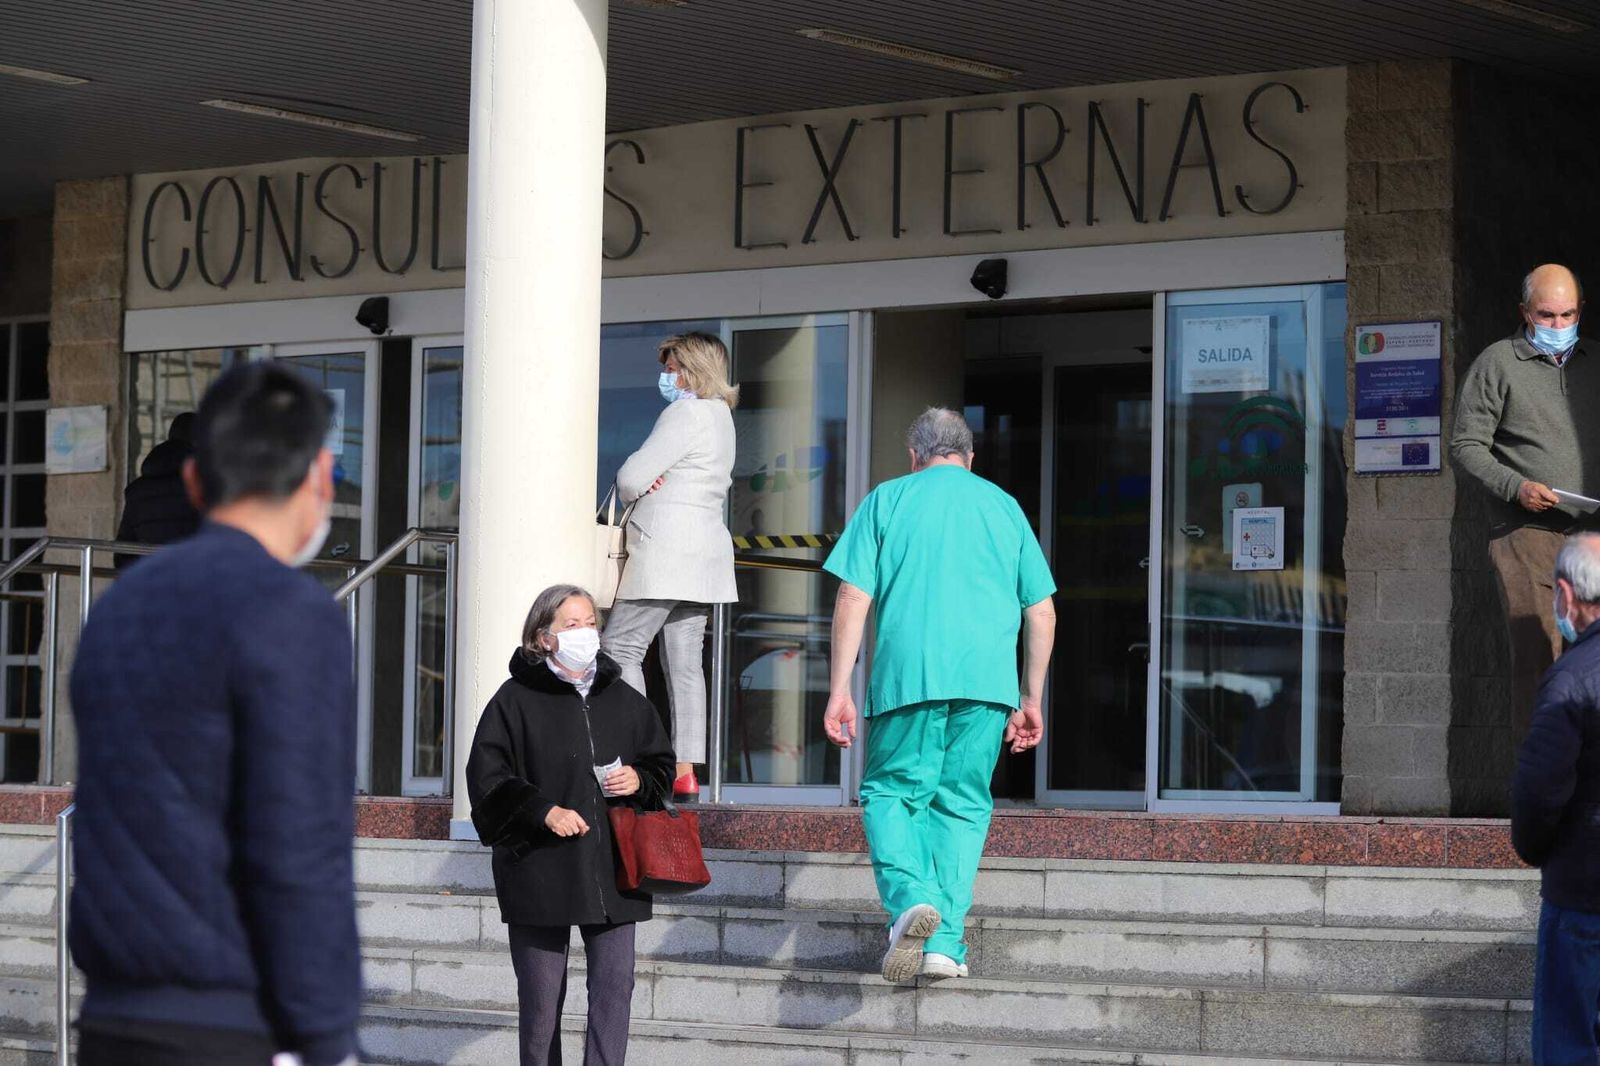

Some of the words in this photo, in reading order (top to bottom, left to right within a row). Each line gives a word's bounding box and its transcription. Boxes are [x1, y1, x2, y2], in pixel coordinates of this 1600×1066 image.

[141, 139, 646, 291] CONSULS
[734, 82, 1307, 249] EXTERNAS
[1198, 348, 1253, 363] SALIDA
